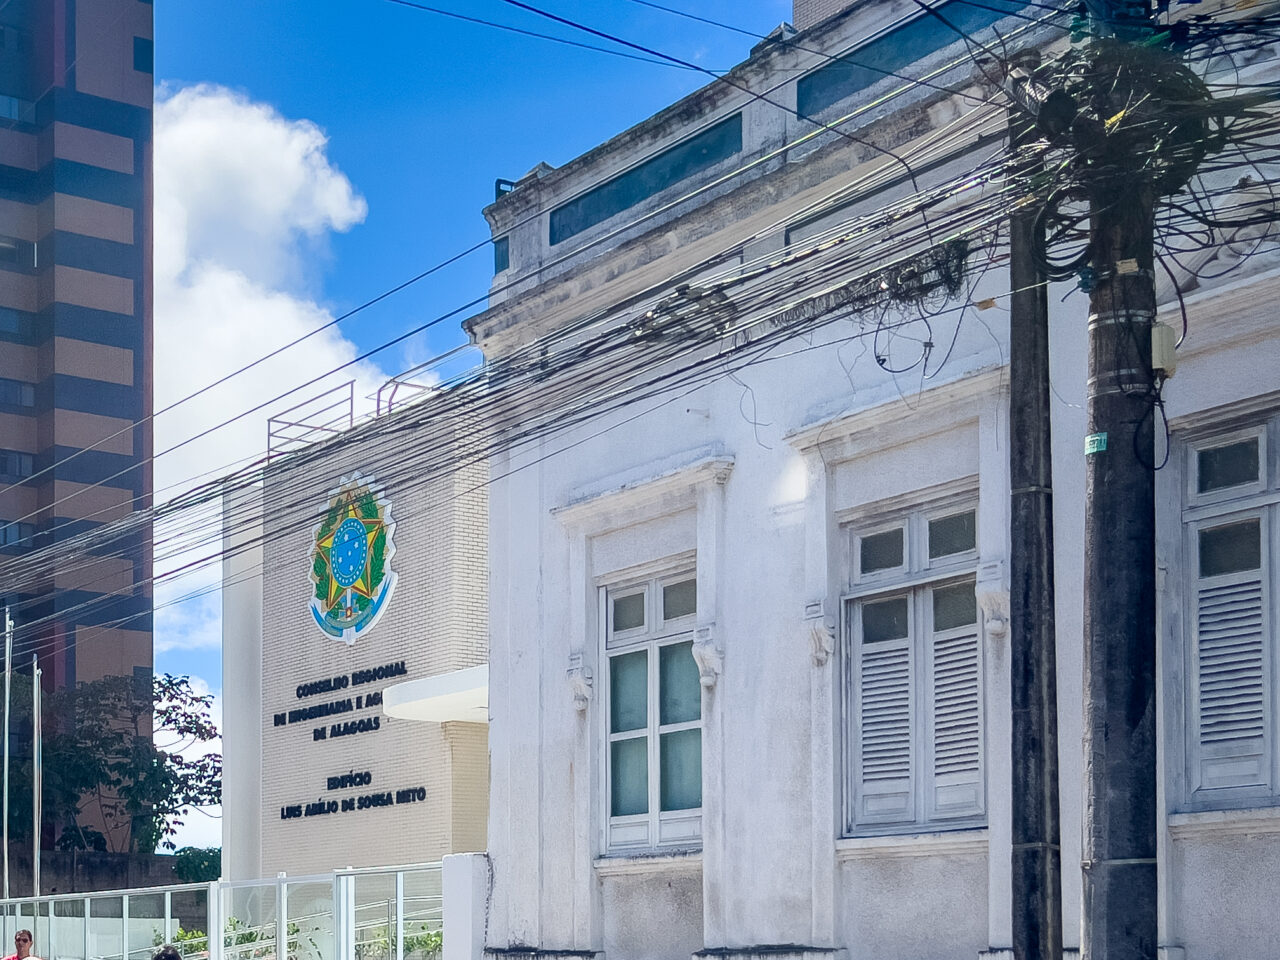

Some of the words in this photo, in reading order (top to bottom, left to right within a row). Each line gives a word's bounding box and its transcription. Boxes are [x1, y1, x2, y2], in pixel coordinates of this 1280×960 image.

[296, 675, 349, 699] CONSELHO
[351, 661, 408, 686] REGIONAL
[274, 712, 287, 727] DE
[288, 698, 353, 724] ENGENHARIA
[356, 695, 363, 710] E
[365, 691, 383, 708] AG
[313, 726, 327, 741] DE
[330, 716, 380, 738] ALAGOAS
[327, 770, 372, 790] EDIFÍCIO
[281, 804, 302, 819] LUIS
[304, 797, 339, 817] ABÍLIO
[341, 798, 355, 812] DE
[357, 791, 394, 810] SOUSA
[396, 786, 426, 804] NETO
